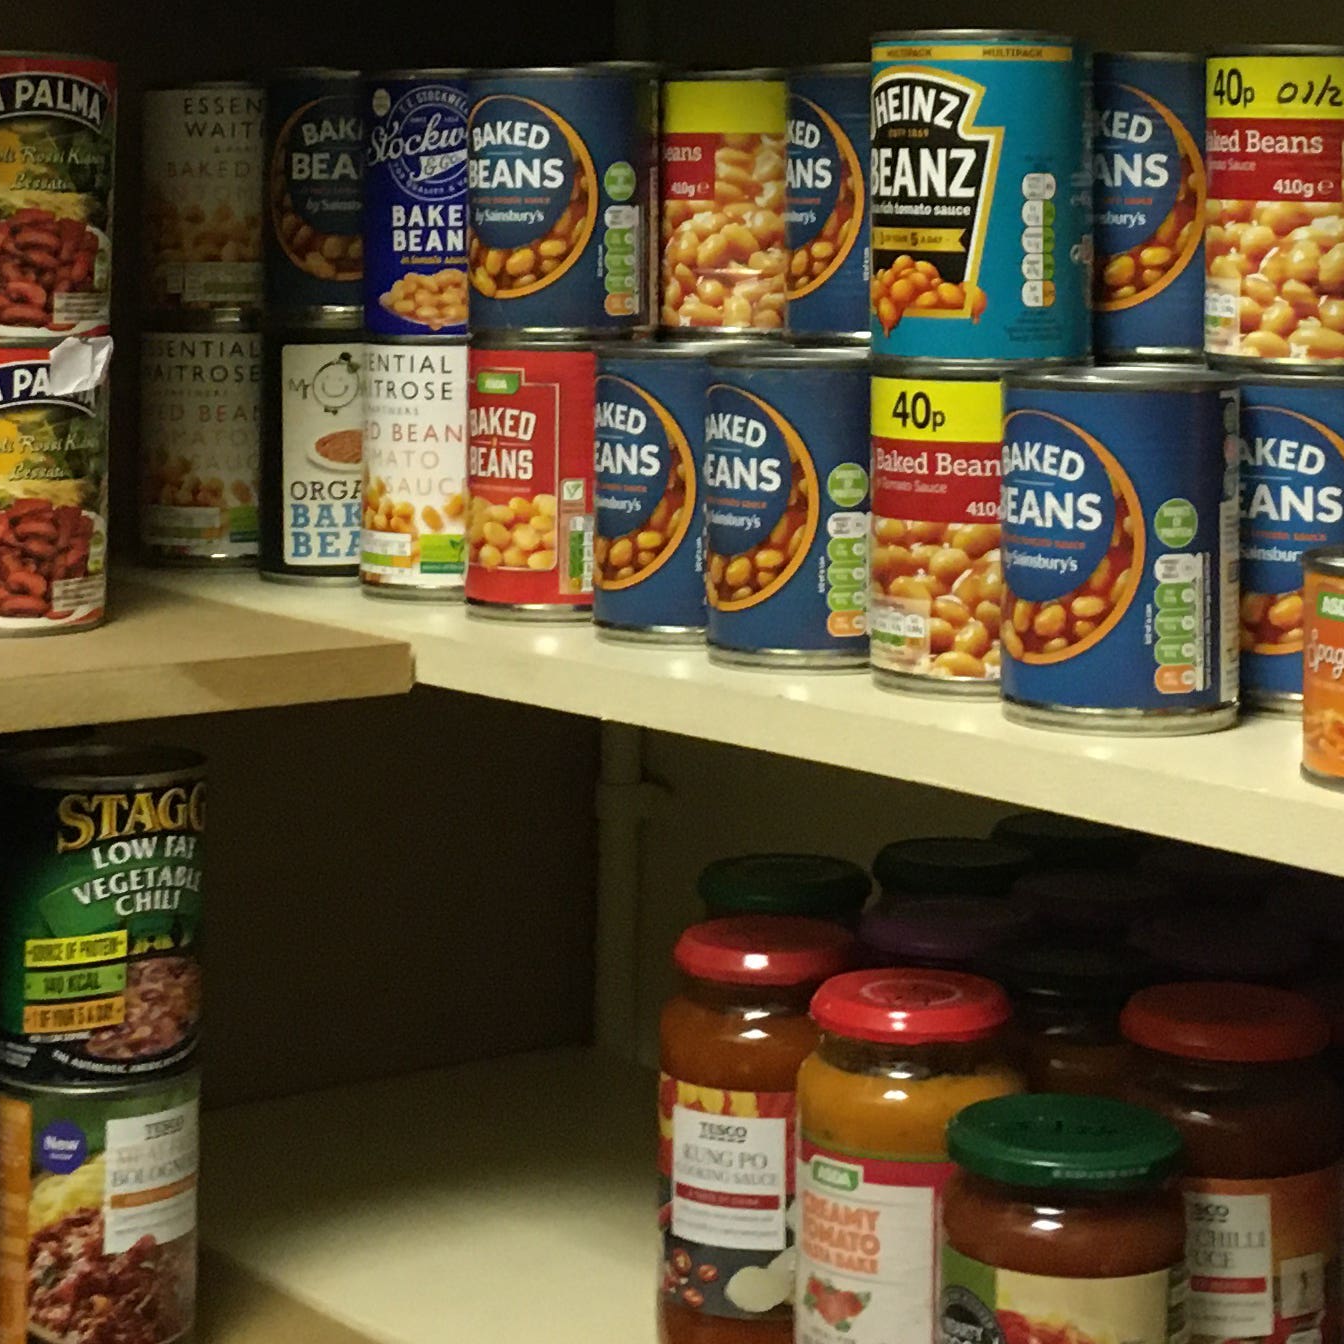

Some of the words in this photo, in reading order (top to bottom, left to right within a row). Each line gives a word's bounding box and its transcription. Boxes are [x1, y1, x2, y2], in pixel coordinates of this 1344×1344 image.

[982, 48, 1044, 58] MULTIPACK
[13, 73, 104, 120] PALMA
[1213, 68, 1256, 109] 40p
[875, 83, 961, 130] HEINZ
[472, 121, 551, 152] BAKED
[1244, 129, 1324, 154] Beans
[468, 157, 565, 190] BEANS
[871, 146, 977, 199] BEANZ
[1272, 178, 1315, 198] 410g
[391, 204, 464, 228] BAKE
[933, 204, 971, 216] sauce
[392, 228, 464, 253] BEAN
[469, 406, 537, 442] BAKED
[892, 389, 947, 433] 40p
[391, 422, 462, 443] BEAN
[468, 447, 535, 480] BEANS
[876, 448, 928, 474] Baked
[913, 480, 948, 494] Sauce
[91, 836, 158, 870] LOW
[114, 889, 182, 917] CHILI
[43, 1135, 80, 1151] New
[698, 1121, 748, 1139] TESCO
